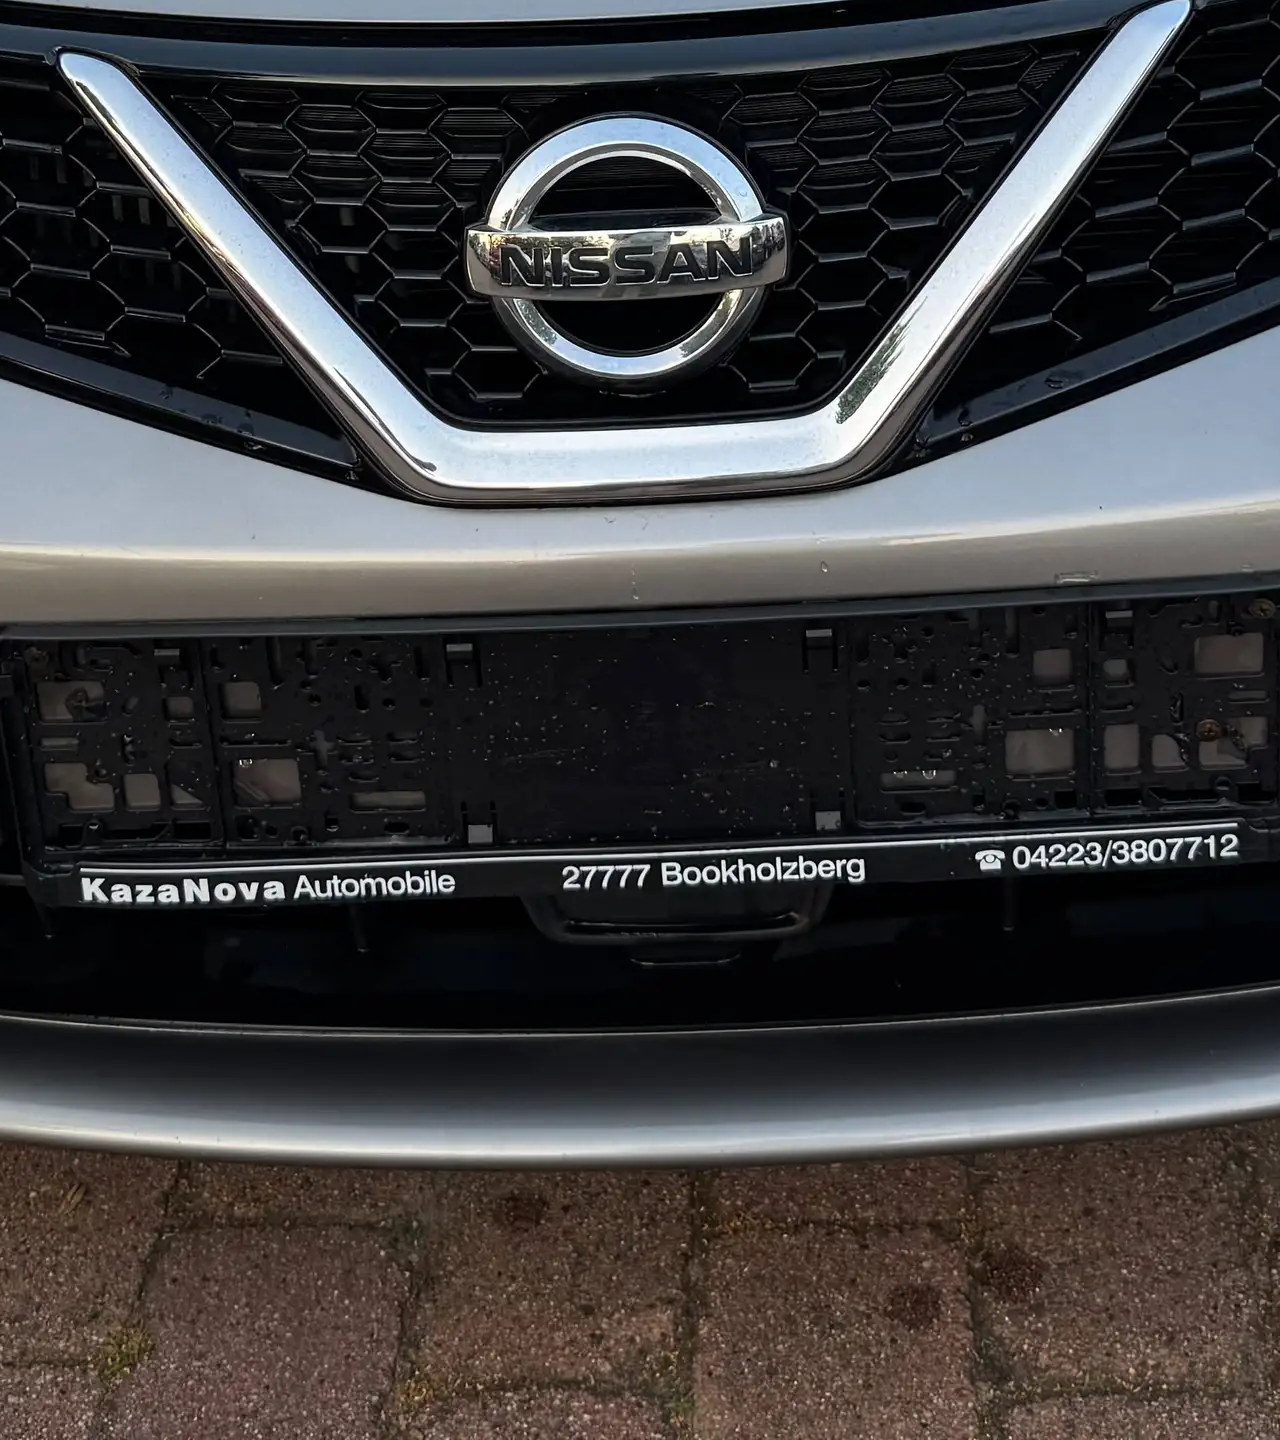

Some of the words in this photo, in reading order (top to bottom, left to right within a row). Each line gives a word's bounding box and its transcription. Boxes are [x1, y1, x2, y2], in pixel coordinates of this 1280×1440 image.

[499, 236, 754, 288] NISSAN
[80, 875, 287, 904] KazaNova
[293, 870, 457, 899] Automobile
[561, 863, 652, 890] 27777
[660, 855, 867, 888] Bookholzberg
[1012, 832, 1240, 871] 04223/3807712
